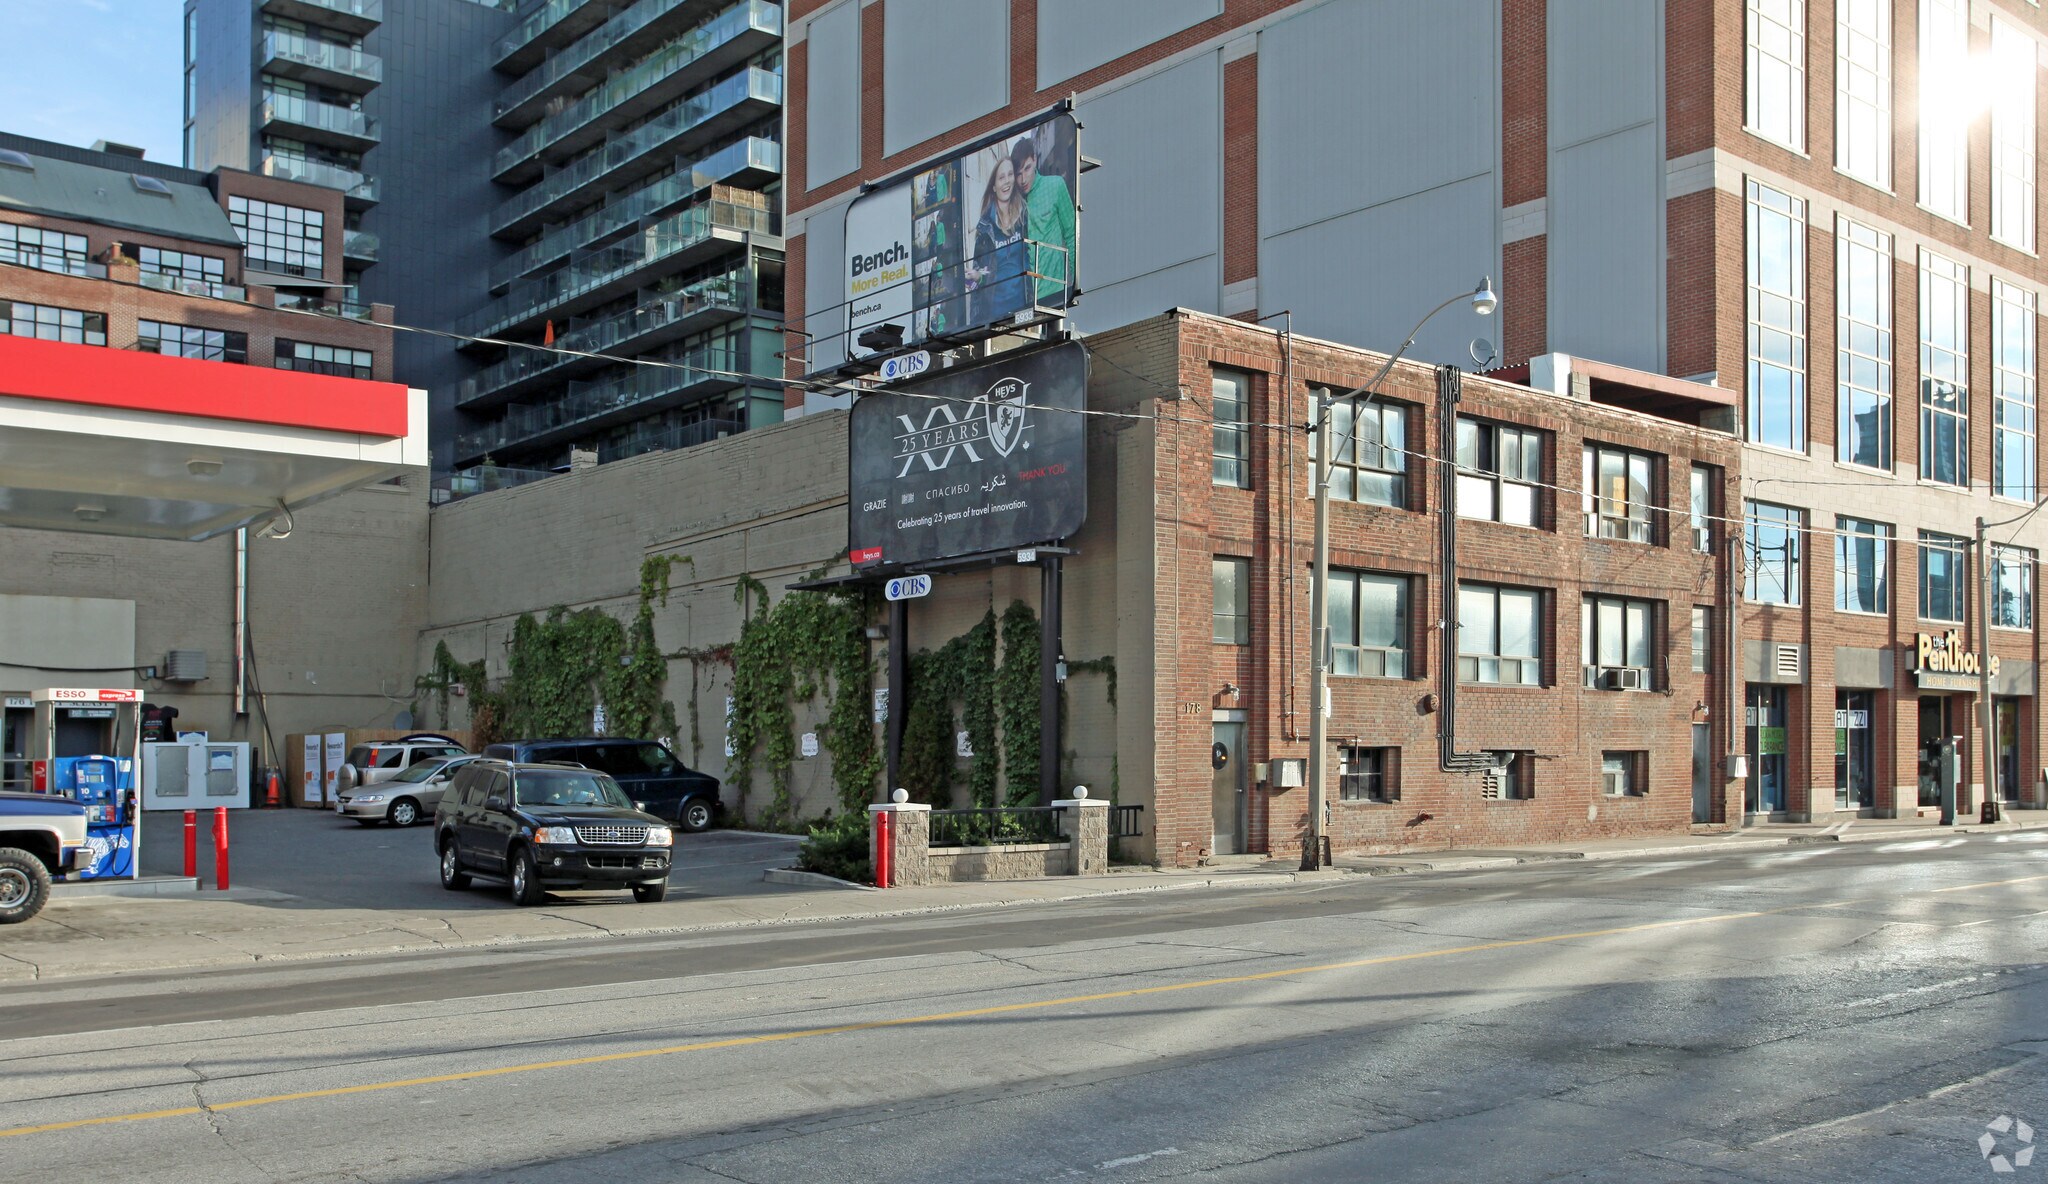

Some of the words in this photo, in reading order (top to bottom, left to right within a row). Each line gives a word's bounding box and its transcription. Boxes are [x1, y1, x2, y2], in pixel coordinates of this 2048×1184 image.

[852, 241, 908, 277] Bench.
[851, 277, 879, 294] More
[881, 264, 908, 284] Real.
[1015, 310, 1033, 324] 5933
[899, 353, 923, 374] CBS
[995, 383, 1016, 398] HEYS
[902, 436, 916, 453] 25
[922, 422, 979, 448] YEARS
[1019, 467, 1046, 480] THANK
[925, 483, 969, 500] СПАСИБО
[863, 498, 887, 512] GRAZIE
[897, 515, 932, 529] Celebrating
[933, 512, 942, 523] 25
[944, 511, 961, 524] years
[963, 507, 971, 518] of
[971, 503, 989, 516] travel
[991, 499, 1028, 513] innovation.
[863, 551, 880, 560] heys.ca
[902, 577, 925, 596] CBS
[1933, 636, 1944, 647] the
[1918, 629, 1999, 676] Penthoue
[1926, 676, 1946, 687] HOME
[56, 690, 86, 698] ESSO
[1185, 702, 1201, 713] 178
